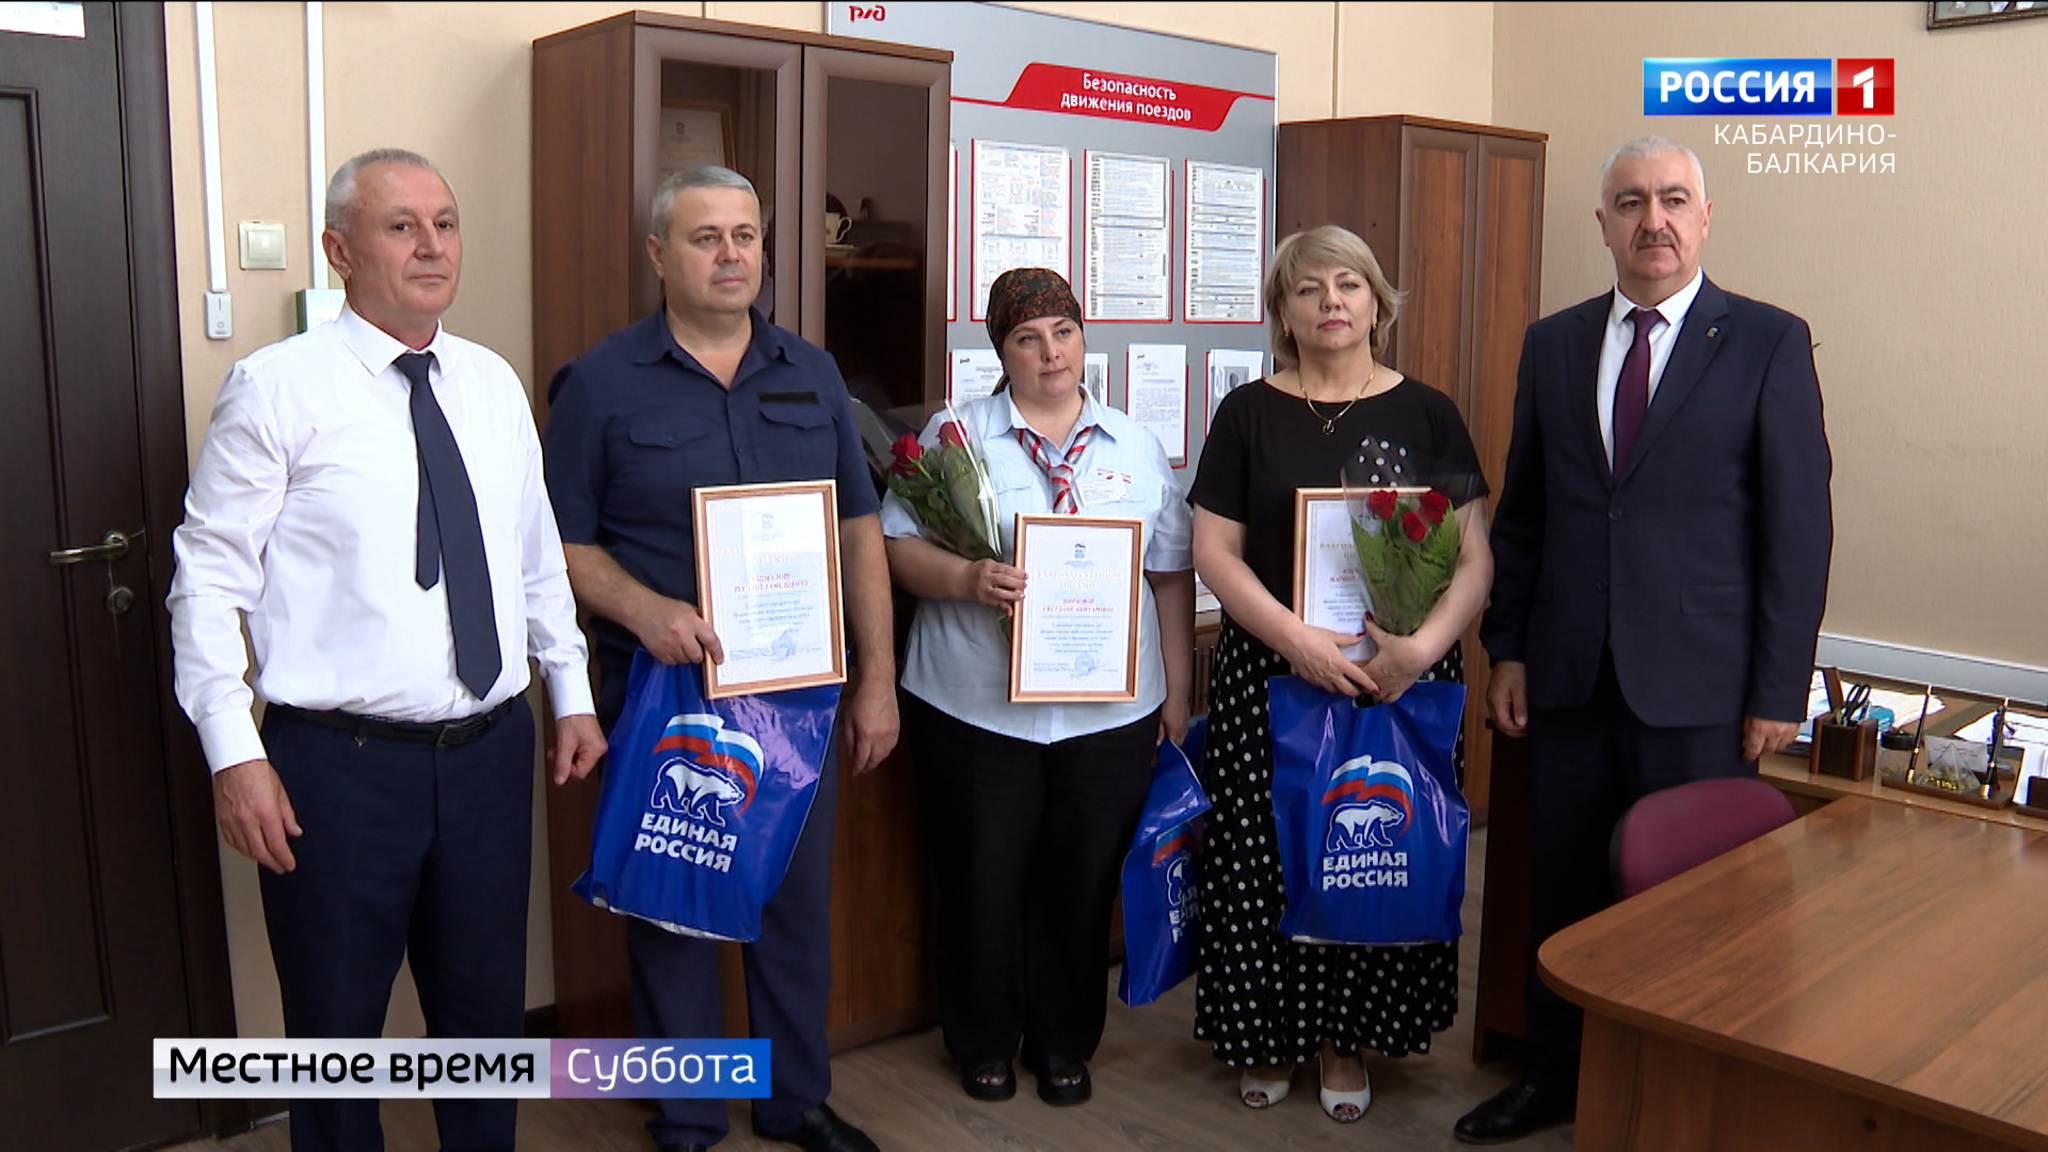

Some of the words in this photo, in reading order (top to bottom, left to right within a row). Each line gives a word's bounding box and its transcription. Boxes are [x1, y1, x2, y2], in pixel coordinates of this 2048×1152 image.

[1083, 72, 1177, 101] Безопасность
[1060, 93, 1133, 113] движения
[1136, 102, 1192, 121] поездов
[640, 812, 738, 852] ЕДИНАЯ
[634, 833, 732, 873] РОССИЯ
[1323, 850, 1408, 873] ЕДИНАЯ
[1322, 869, 1409, 892] РОССИЯ
